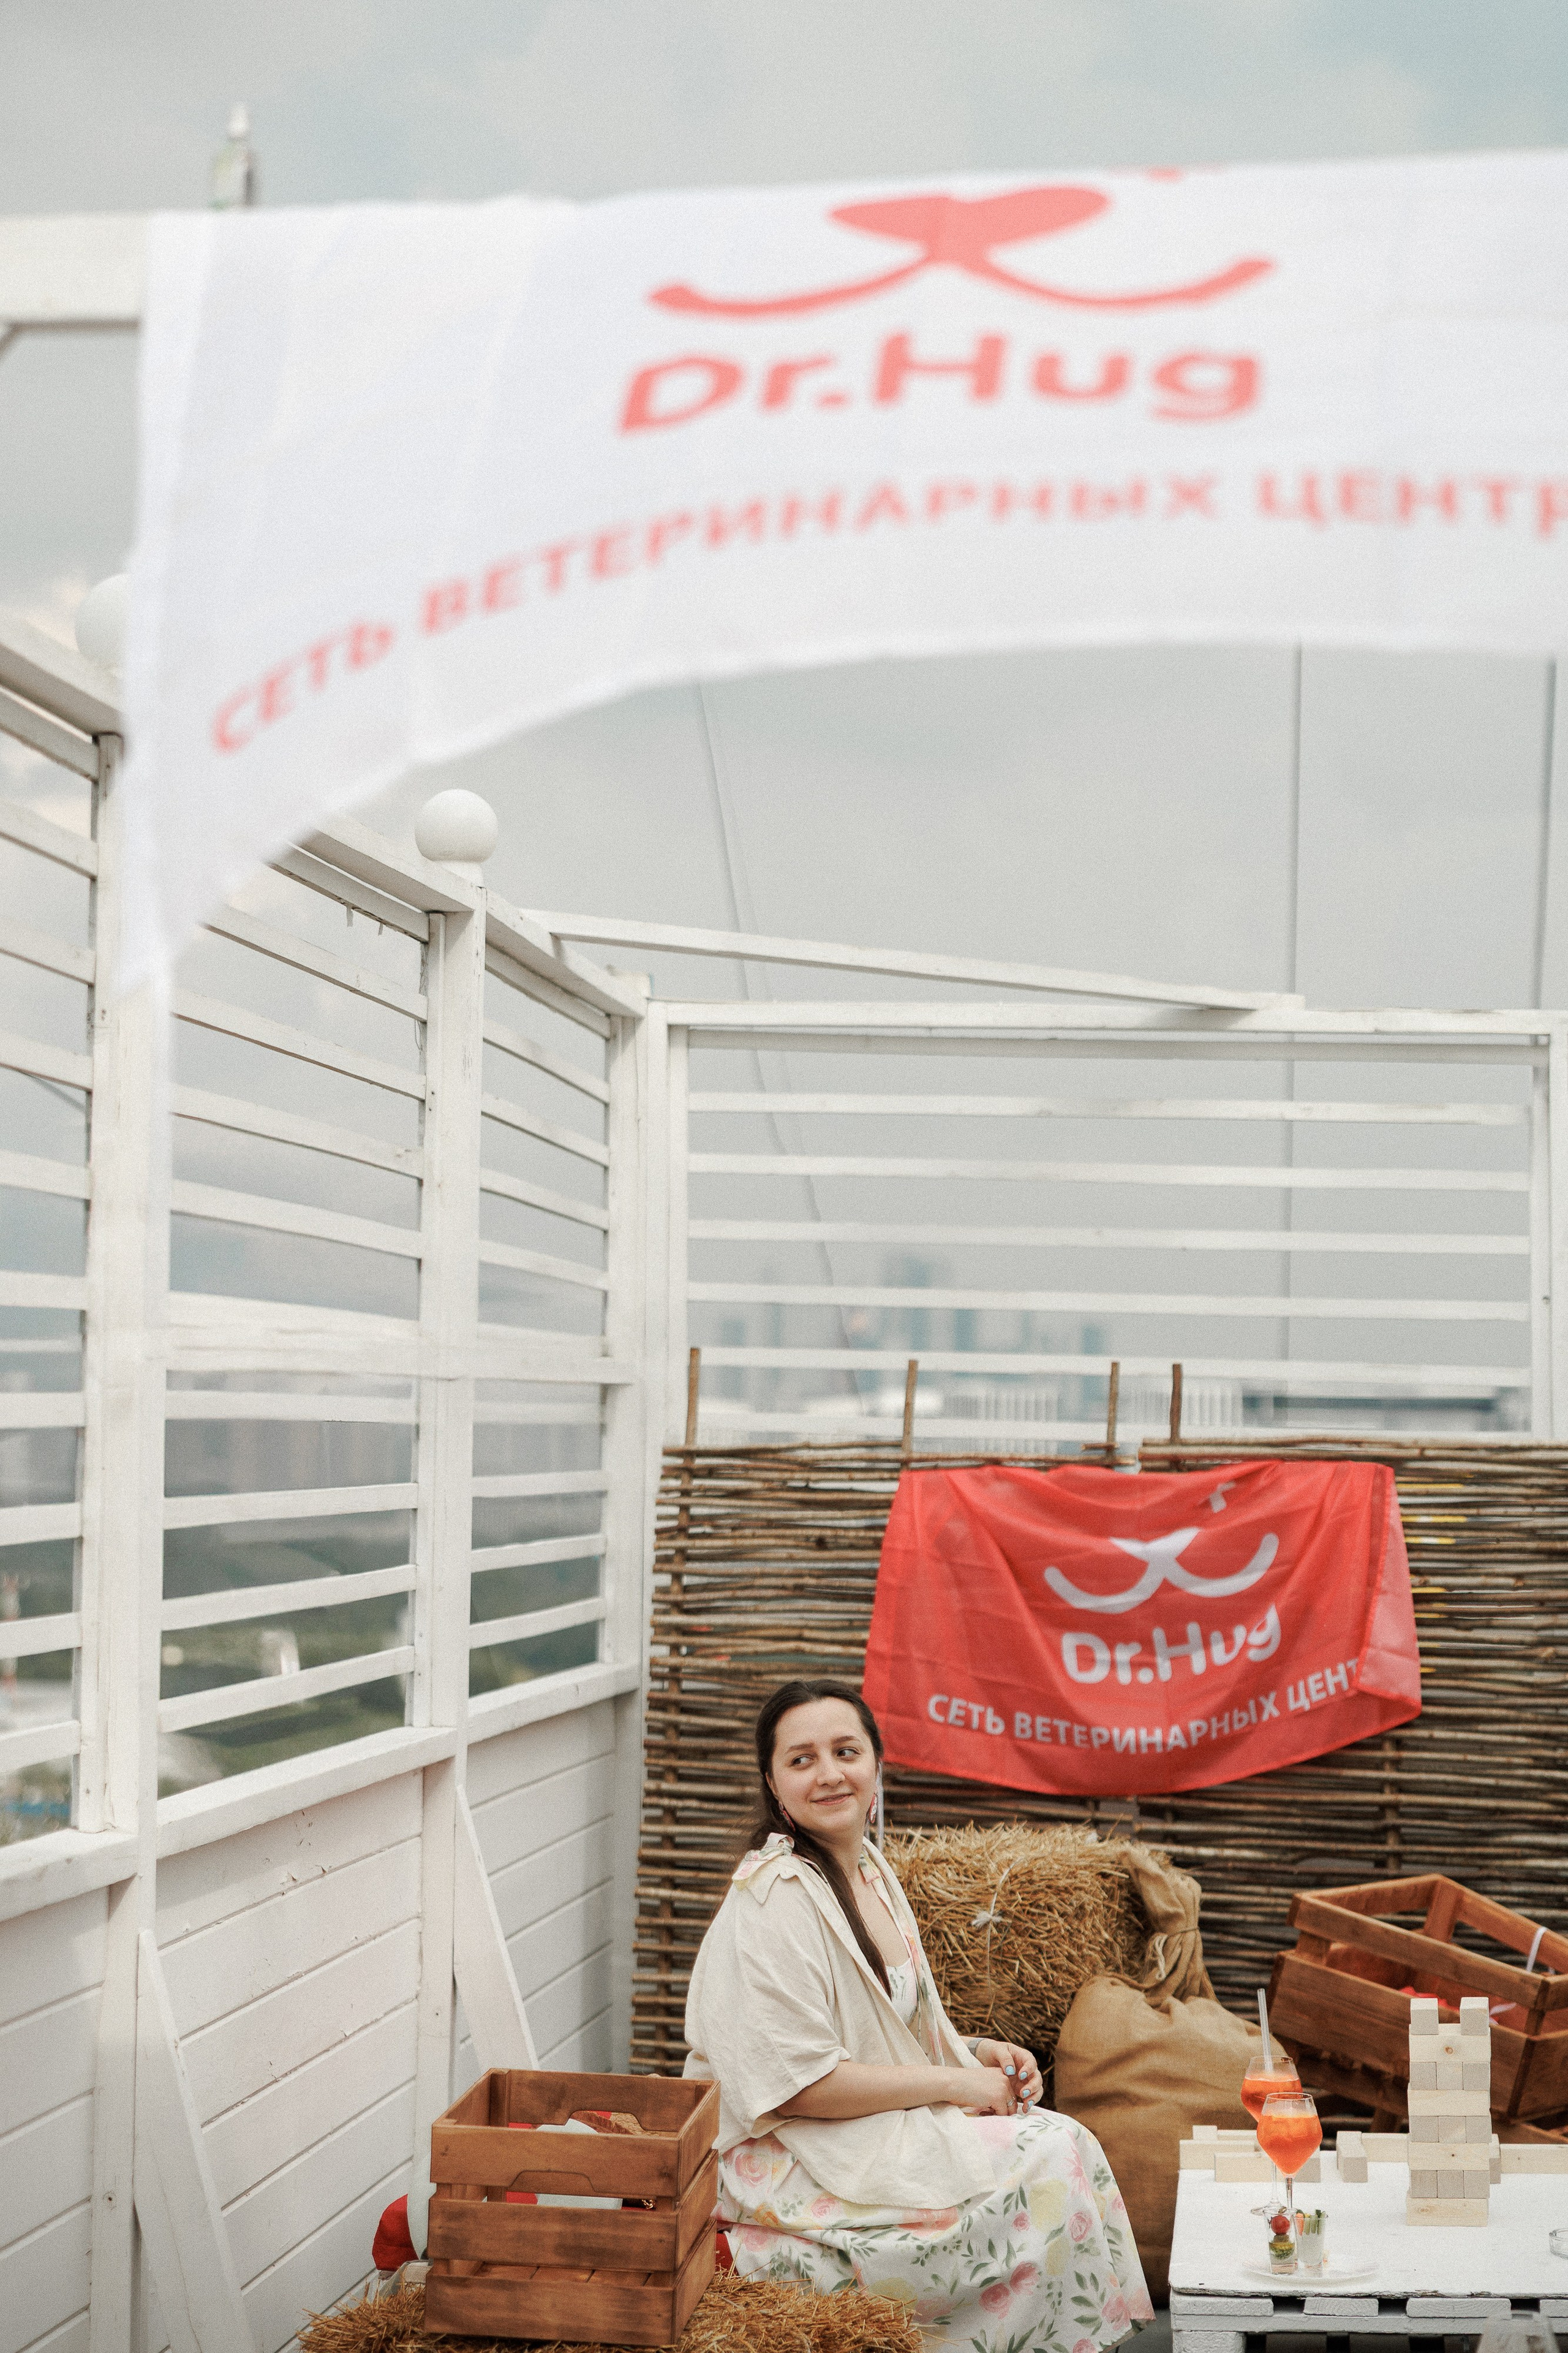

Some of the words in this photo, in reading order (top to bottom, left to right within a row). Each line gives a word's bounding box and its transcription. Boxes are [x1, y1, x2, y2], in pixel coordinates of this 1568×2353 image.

[619, 332, 1262, 436] Dr.Hug
[211, 618, 395, 752] СЕТЬ
[420, 477, 1216, 634] ВЕТЕРИНАРНЫХ
[1061, 1603, 1281, 1685] Dr.Hug
[927, 1694, 1005, 1735] СЕТЬ
[1014, 1691, 1280, 1754] ВЕТЕРИНАРНЫХ
